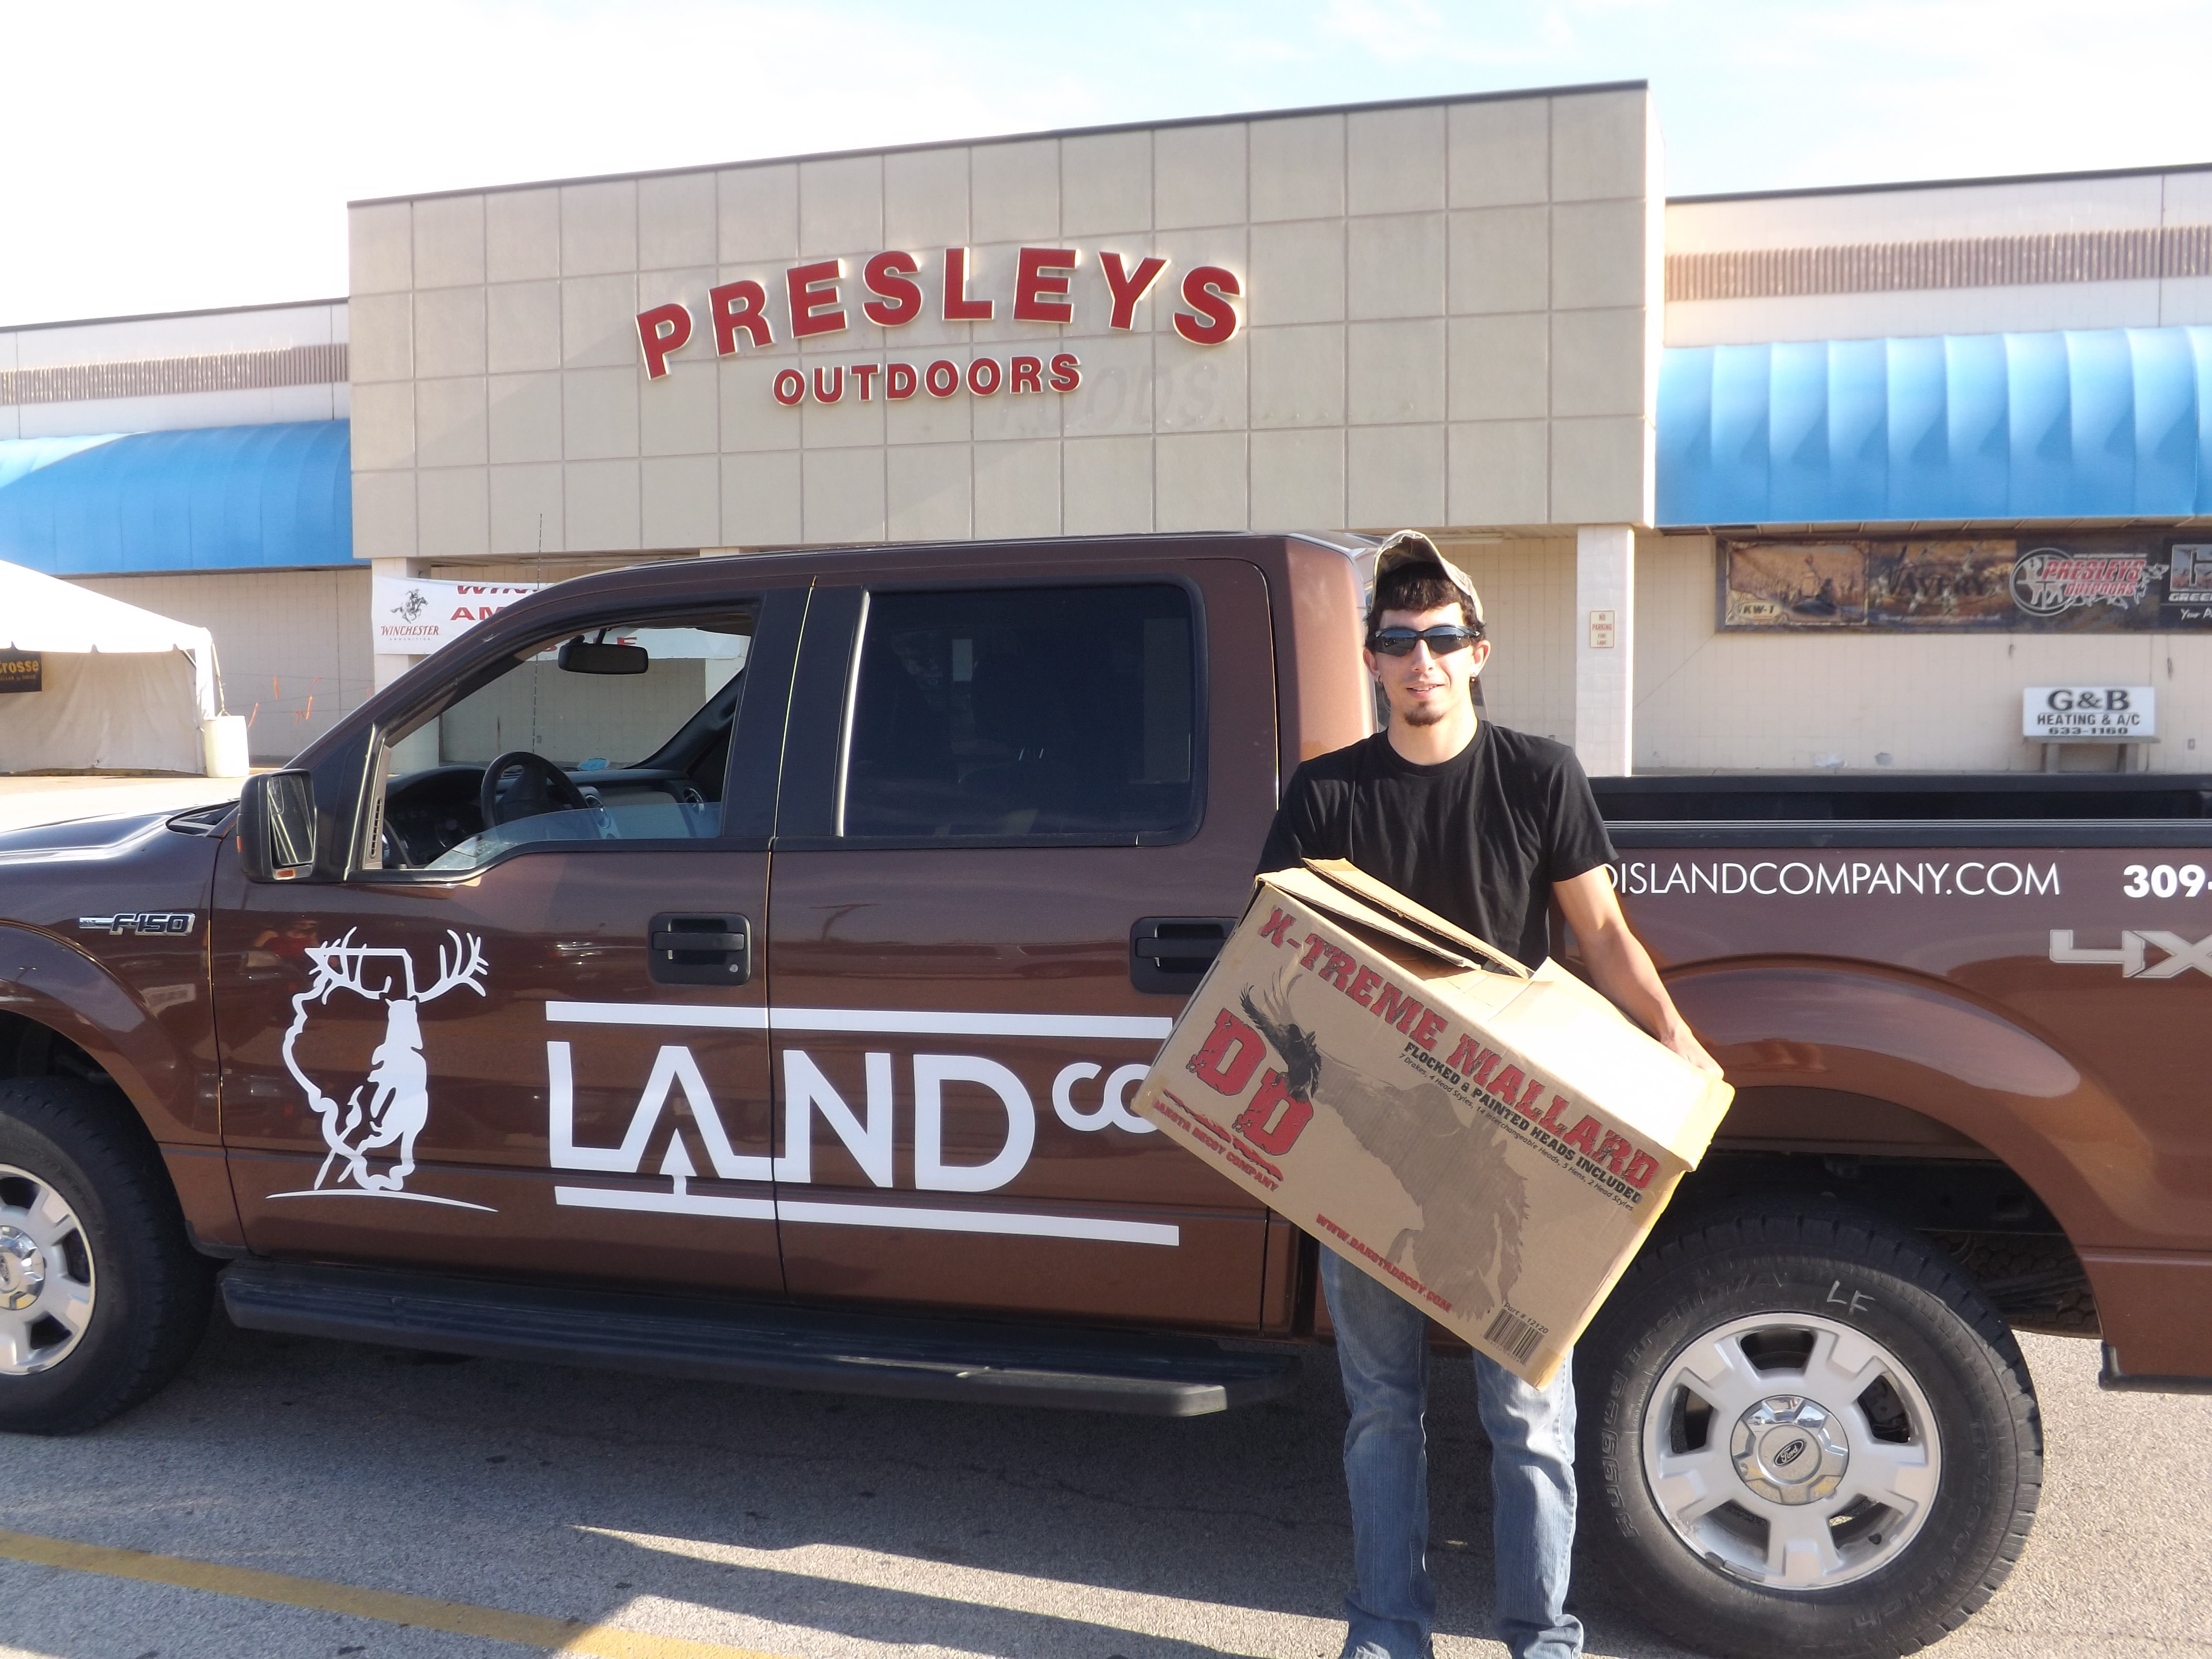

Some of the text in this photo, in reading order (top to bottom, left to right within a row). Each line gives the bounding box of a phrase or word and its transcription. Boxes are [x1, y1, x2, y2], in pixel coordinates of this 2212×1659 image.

[636, 247, 1245, 381] PRESLEYS
[773, 353, 1082, 406] OUTDOORS
[2041, 560, 2146, 581] PRESLEYS
[1744, 605, 1774, 614] KW-1
[2168, 593, 2212, 602] GREE
[2203, 607, 2212, 619] P
[381, 625, 439, 636] WINCHESTER
[2047, 689, 2130, 711] G&B
[2037, 714, 2140, 726] HEATING & A/C
[108, 912, 196, 937] F-150
[1258, 905, 1664, 1194] X-TREME MALLARD
[546, 1040, 1035, 1193] LAND
[1403, 1041, 1462, 1086] FLOCKED
[1470, 1086, 1530, 1132] PAINTED
[1530, 1126, 1576, 1162] HEADS
[1575, 1156, 1643, 1205] INCLUDED
[1404, 1056, 1429, 1078] Drakes,
[1434, 1077, 1453, 1093] Head
[1452, 1090, 1475, 1109] Styles,
[1476, 1105, 1486, 1115] 14
[1537, 1146, 1562, 1166] Heads,
[1567, 1166, 1587, 1183] Hens,
[1592, 1182, 1613, 1199] Head
[1191, 1126, 1227, 1156] DECOY
[1225, 1150, 1280, 1193] COMPANY
[1315, 1213, 1453, 1313] WWW.DAKOTADECOY.COM
[1504, 1303, 1520, 1315] Part
[1527, 1318, 1549, 1334] 12120
